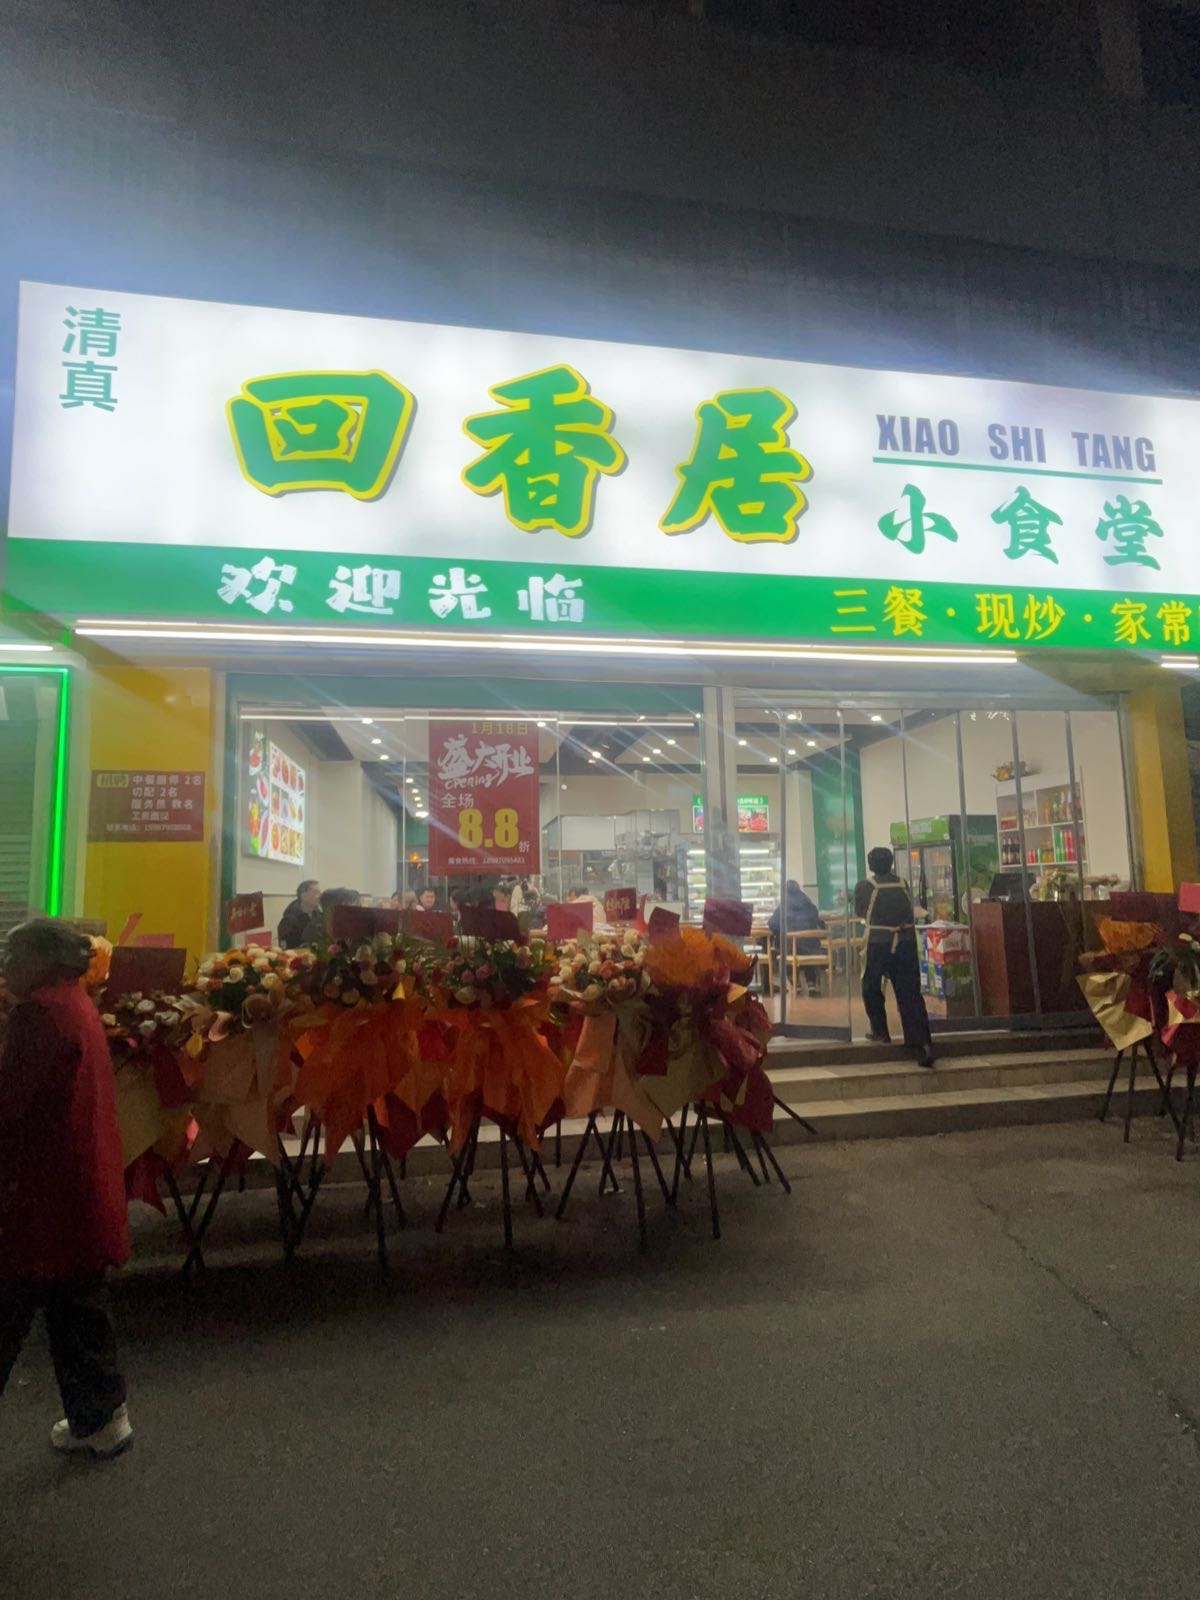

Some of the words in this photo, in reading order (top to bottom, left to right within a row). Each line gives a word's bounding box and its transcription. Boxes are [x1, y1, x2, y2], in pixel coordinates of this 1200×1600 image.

[59, 306, 122, 412] 清真
[225, 364, 812, 543] 回香居
[876, 414, 960, 457] XIAO
[988, 424, 1046, 463] SHI
[1071, 431, 1157, 473] TANG
[877, 483, 1164, 571] 小食堂
[216, 555, 586, 624] 欢迎光临
[830, 585, 1200, 646] 三餐·现炒·家常
[441, 793, 474, 808] 全场
